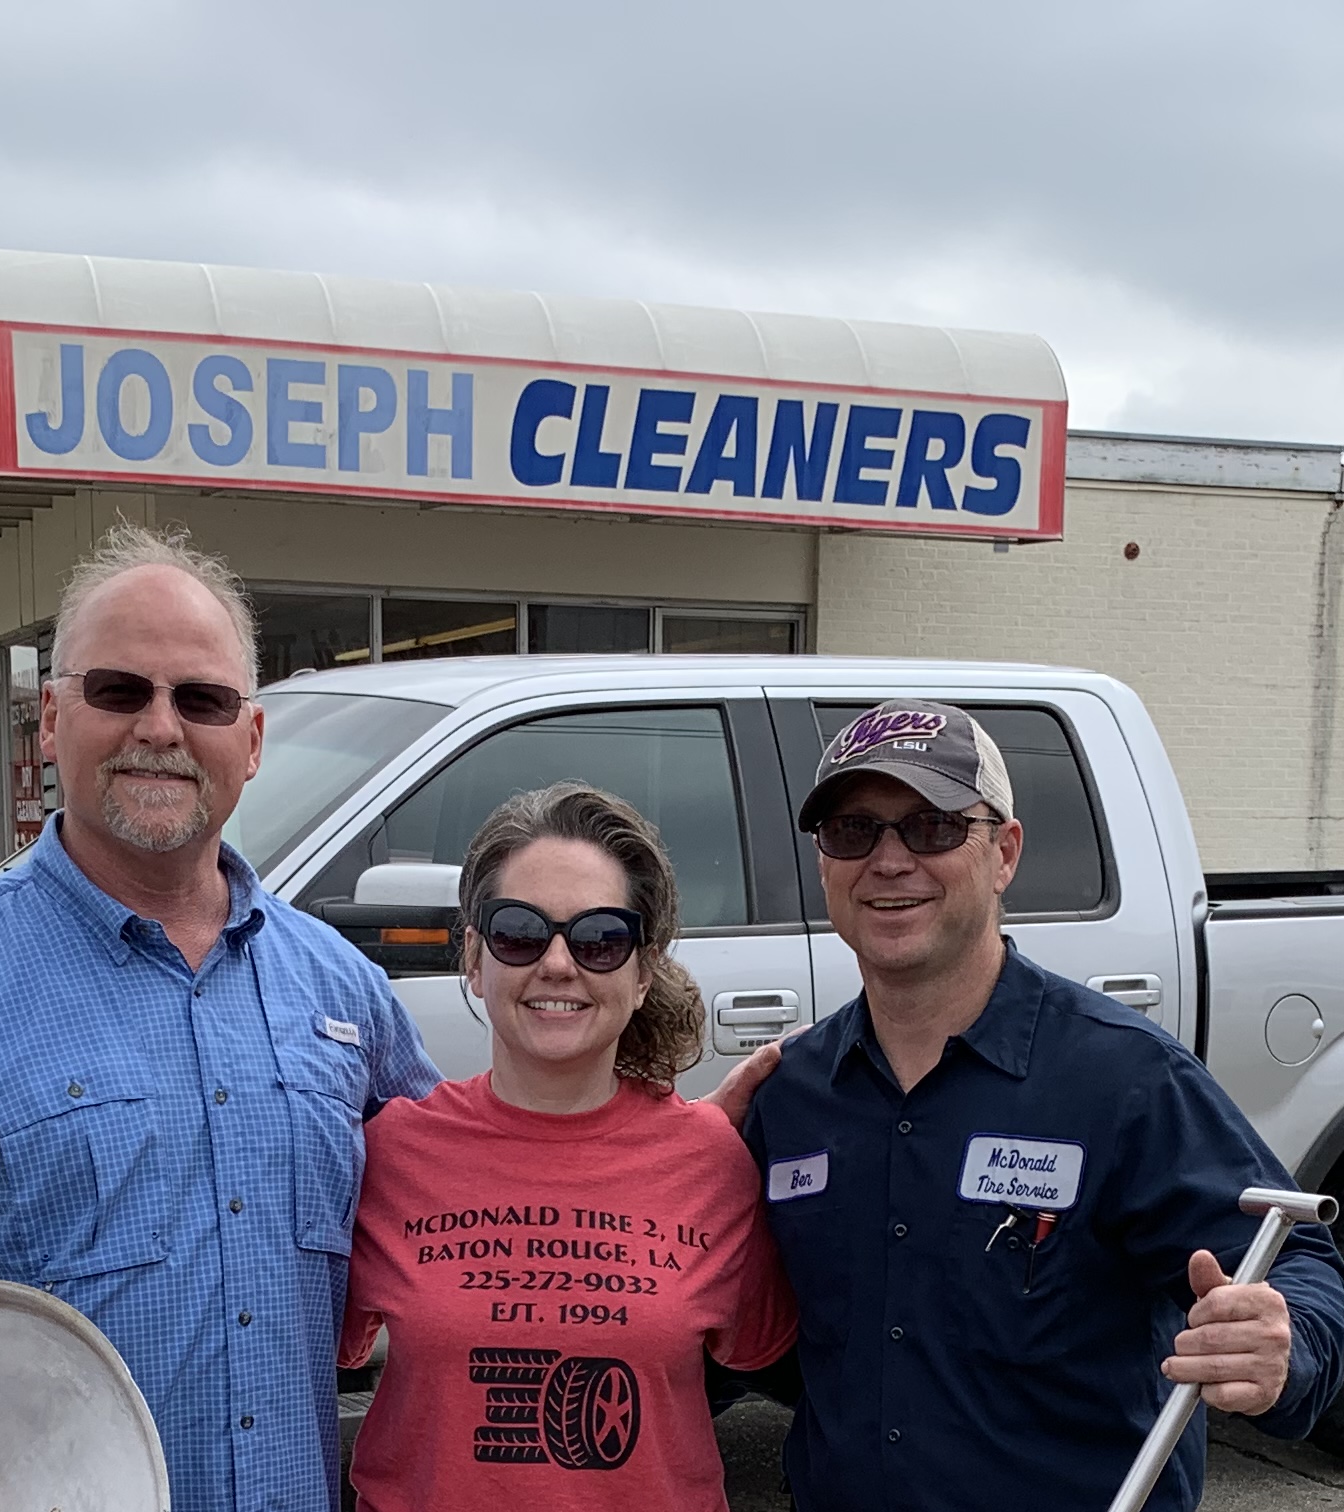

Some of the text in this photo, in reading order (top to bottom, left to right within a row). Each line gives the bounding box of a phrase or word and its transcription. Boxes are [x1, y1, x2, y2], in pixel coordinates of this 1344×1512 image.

[25, 343, 474, 480] JOSEPH
[509, 379, 1031, 517] CLEANERS
[831, 708, 947, 764] Tigers
[892, 741, 927, 752] LSU
[987, 1148, 1058, 1173] McDonald
[790, 1170, 813, 1190] Ben
[977, 1175, 1059, 1200] Tire Service
[404, 1206, 711, 1252] MCDONALD TIRE 2, LLC
[417, 1237, 683, 1272] BATON ROUGE, LA
[459, 1270, 659, 1296] 225-272-9032
[491, 1302, 629, 1326] EST. 1994
